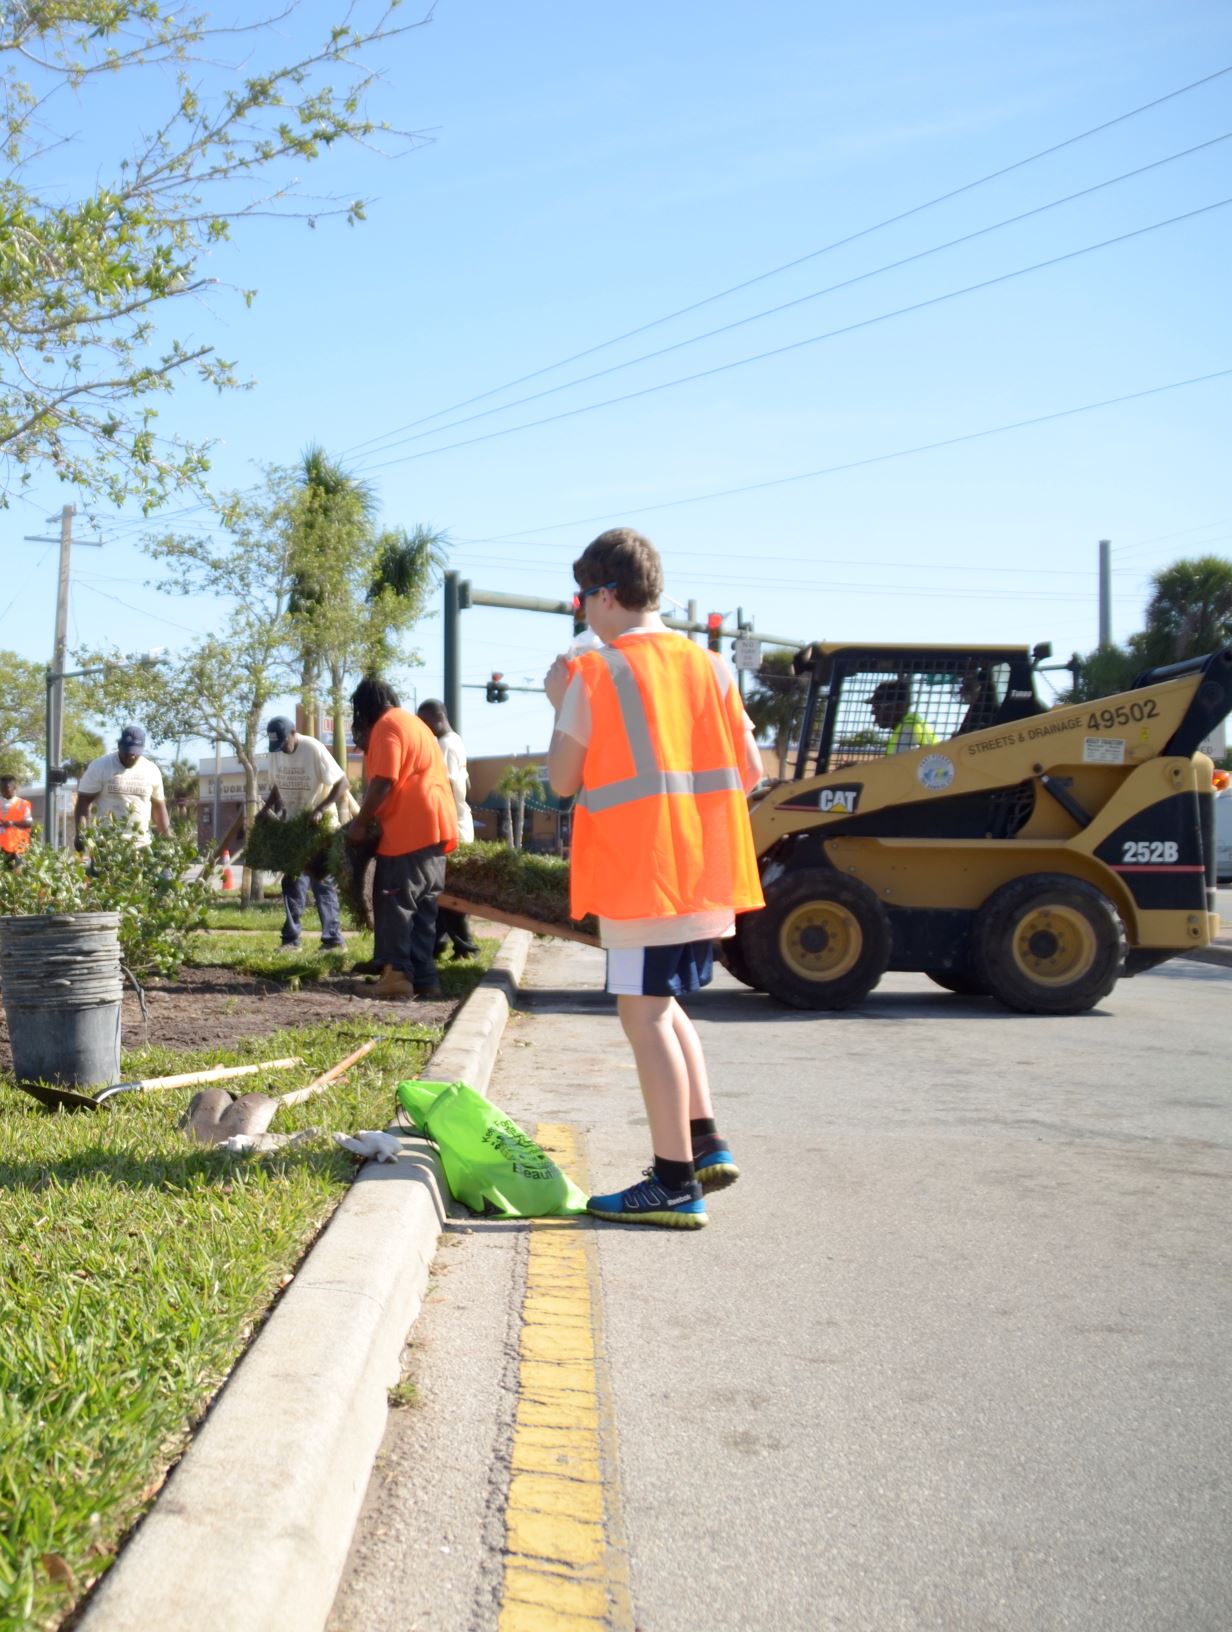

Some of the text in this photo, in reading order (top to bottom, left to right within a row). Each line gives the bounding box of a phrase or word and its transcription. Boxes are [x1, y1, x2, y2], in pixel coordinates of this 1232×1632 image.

[968, 699, 1160, 756] STREETS & DRAINAGE 49502
[820, 789, 857, 813] CAT
[1122, 841, 1179, 863] 252B
